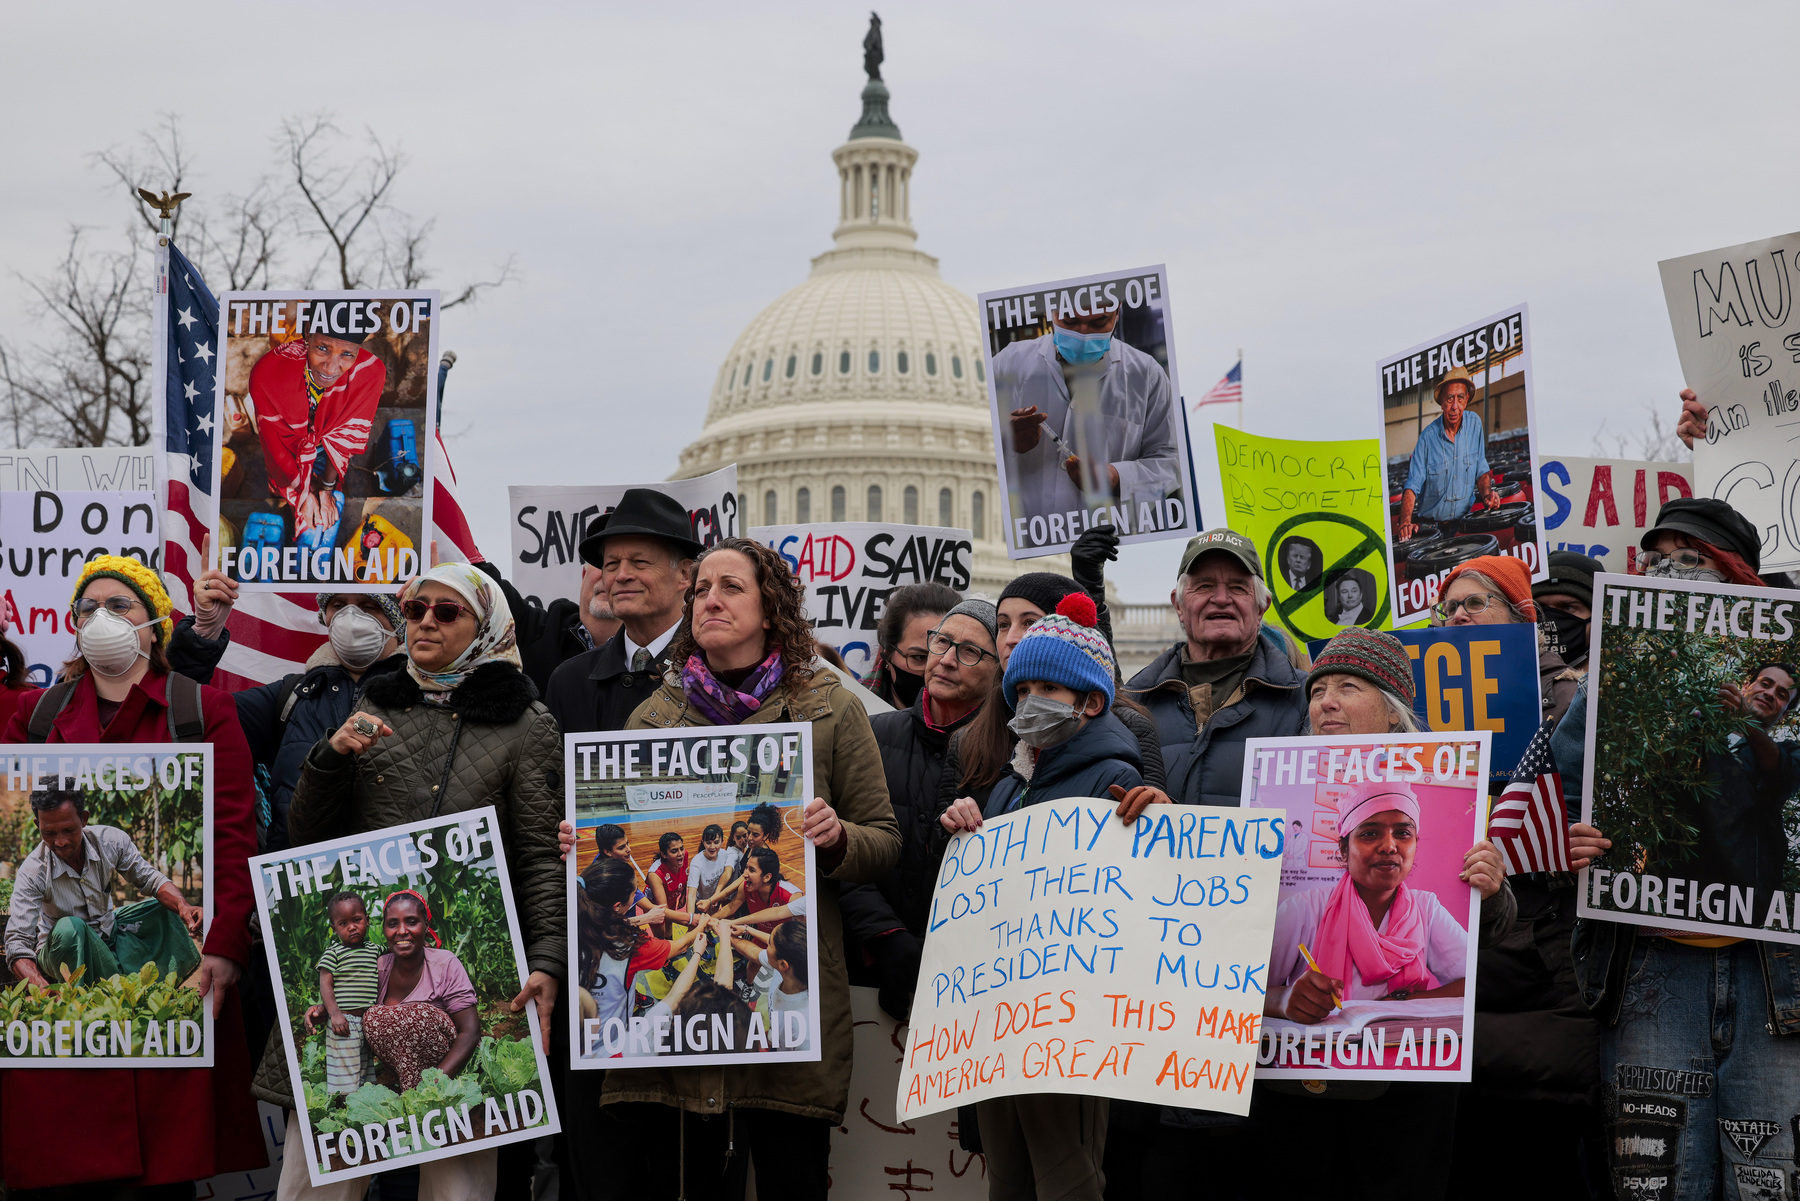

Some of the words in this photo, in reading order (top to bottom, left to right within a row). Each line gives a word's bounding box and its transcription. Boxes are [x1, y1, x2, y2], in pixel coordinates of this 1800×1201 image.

[988, 296, 1039, 330] THE
[1046, 283, 1120, 322] FACES
[1125, 276, 1158, 309] OF
[1694, 249, 1800, 338] MU
[230, 302, 286, 334] THE
[297, 301, 382, 334] FACES
[390, 301, 428, 333] OF
[1384, 355, 1423, 395] THE
[1428, 328, 1488, 378] FACES
[1492, 316, 1520, 352] OF
[1739, 341, 1772, 378] is
[1705, 403, 1749, 445] an
[1763, 379, 1800, 417] ille
[33, 490, 157, 535] Don
[1229, 474, 1256, 508] DO
[1014, 504, 1131, 548] FOREIGN
[1138, 498, 1185, 532] AID
[1225, 535, 1243, 547] ACT
[221, 546, 354, 581] FOREIGN
[363, 546, 419, 581] AID
[769, 532, 856, 583] SAID
[861, 533, 972, 591] SAVES
[1606, 588, 1676, 631] THE
[1686, 595, 1794, 641] FACES
[59, 756, 151, 791] FACES
[160, 756, 200, 791] OF
[578, 743, 641, 781] THE
[651, 738, 748, 778] FACES
[757, 735, 798, 772] OF
[1256, 748, 1318, 786] THE
[1326, 745, 1424, 784] FACES
[1433, 744, 1476, 781] OF
[650, 790, 683, 800] USAID
[264, 855, 333, 901] THE
[338, 832, 439, 887] FACES
[444, 822, 488, 864] OF
[940, 815, 1032, 888] BOTH
[1042, 806, 1112, 854] MY
[1131, 812, 1284, 859] PARENTS
[930, 878, 1004, 933] LOST
[1024, 863, 1134, 902] THEIR
[1152, 873, 1253, 907] JOBS
[1592, 868, 1755, 925] FOREIGN
[990, 907, 1119, 950] THANKS
[1148, 917, 1202, 946] TO
[931, 943, 1124, 1008] PRESIDENT
[1155, 952, 1267, 995] MUSK
[0, 1019, 132, 1056] OREIGN
[142, 1019, 202, 1056] AID
[583, 1012, 735, 1056] FOREIGN
[745, 1010, 807, 1050] AID
[910, 1009, 980, 1069] HOW
[993, 990, 1076, 1042] DOES
[1103, 994, 1176, 1032] THIS
[1196, 1005, 1262, 1045] MAKE
[1395, 1027, 1460, 1068] AID
[905, 1052, 1006, 1112] AMERICA
[1021, 1037, 1145, 1081] GREAT
[1155, 1051, 1250, 1095] AGAIN
[316, 1101, 475, 1173] FOREIGN
[483, 1089, 544, 1135] AID
[1622, 1102, 1677, 1118] NO-HEADS
[1737, 1166, 1780, 1179] SUICIDAL
[1739, 1175, 1782, 1191] TENDENCIES
